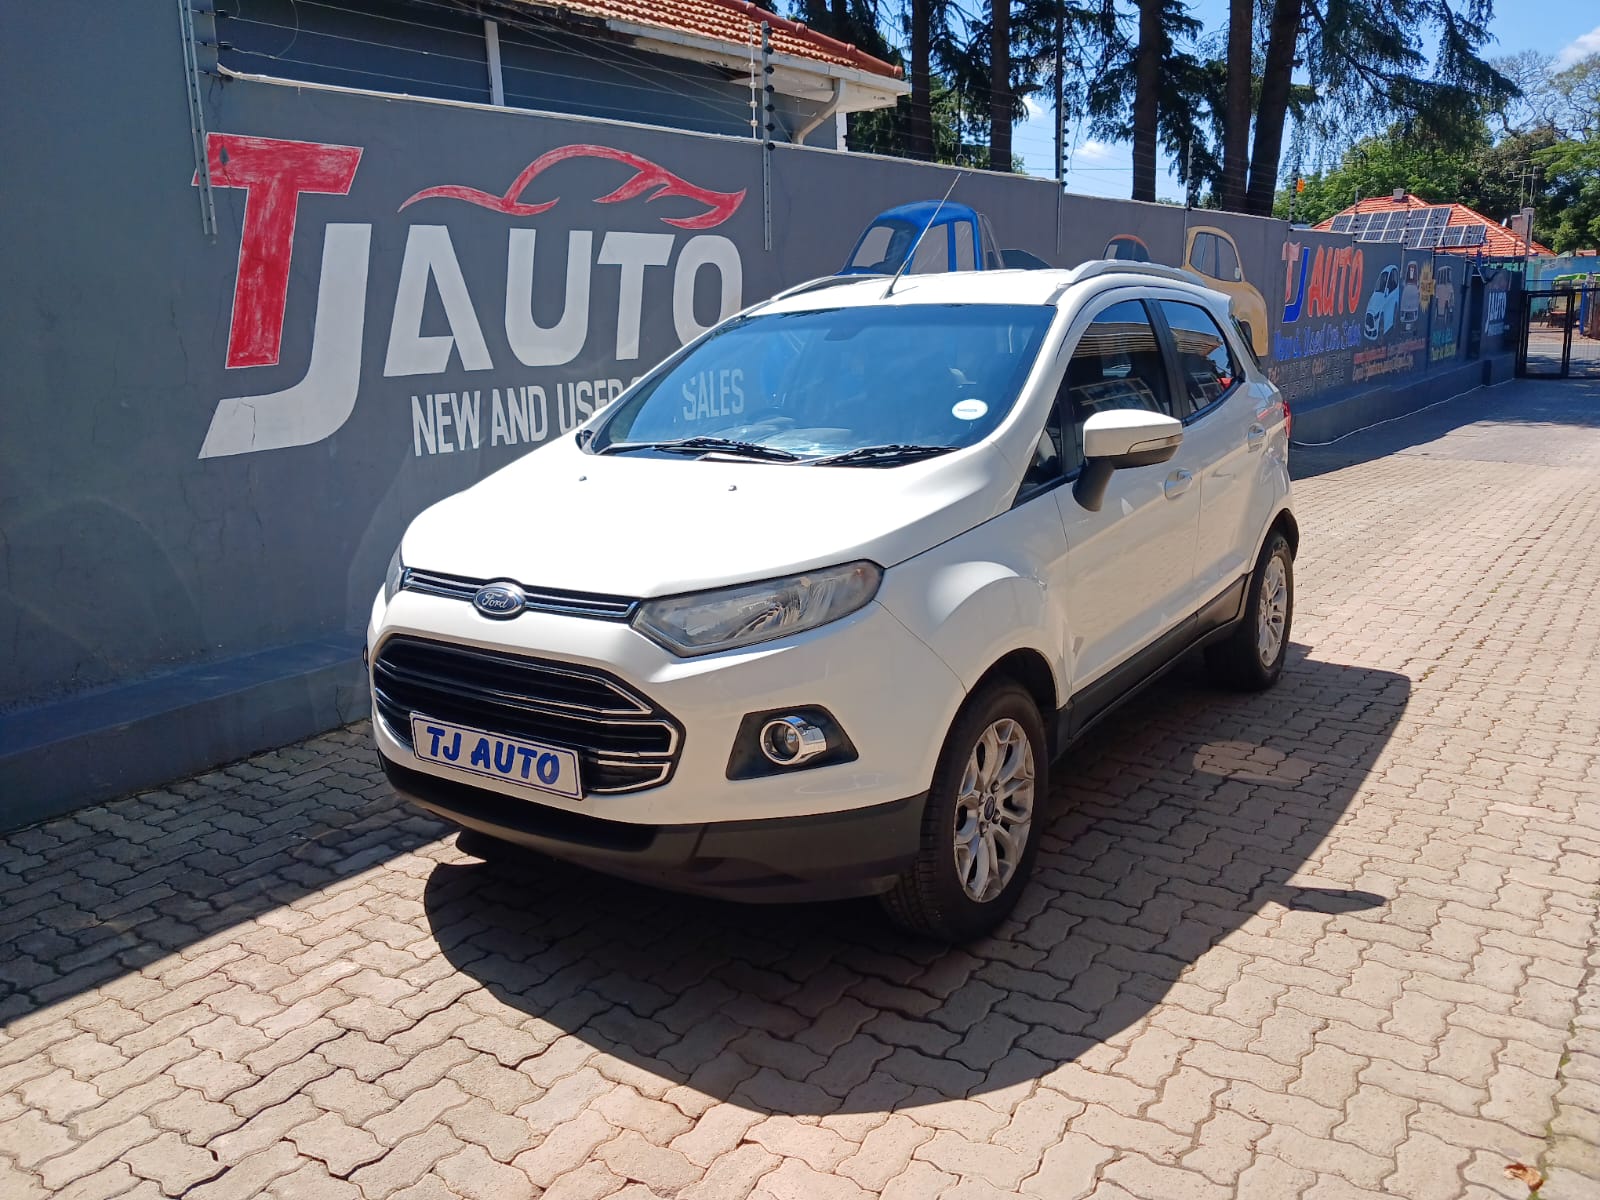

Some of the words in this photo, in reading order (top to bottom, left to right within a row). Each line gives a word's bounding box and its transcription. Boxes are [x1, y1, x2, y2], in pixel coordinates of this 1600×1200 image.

[191, 132, 372, 459] TJ
[383, 225, 743, 377] AUTO
[1281, 242, 1310, 323] TJ
[1307, 245, 1363, 317] AUTO
[411, 390, 481, 457] NEW
[491, 384, 548, 447] AND
[682, 369, 745, 421] SALES
[481, 592, 509, 610] Ford
[426, 726, 462, 761] TJ
[470, 737, 560, 785] AUTO
